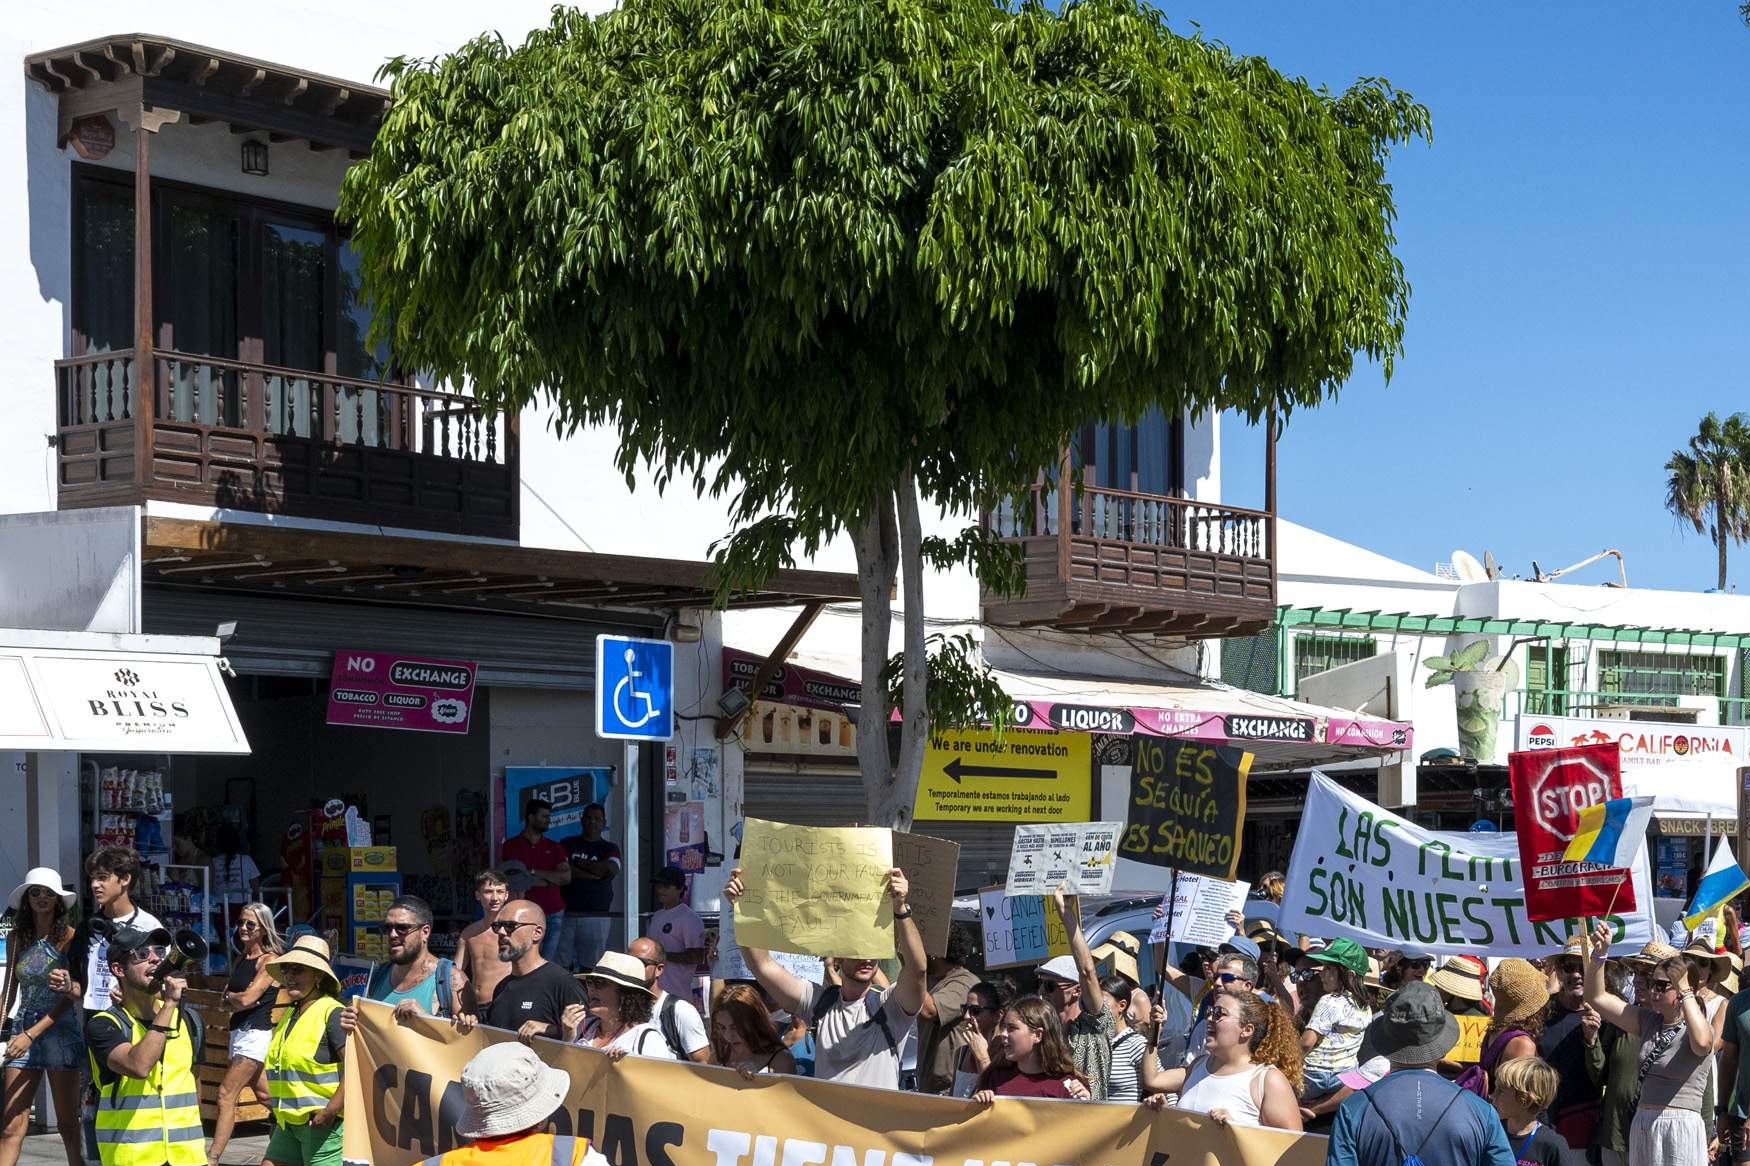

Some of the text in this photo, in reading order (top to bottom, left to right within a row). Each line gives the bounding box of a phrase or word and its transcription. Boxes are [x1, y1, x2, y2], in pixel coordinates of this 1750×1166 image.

[347, 656, 375, 673] NO
[394, 666, 467, 685] EXCHANGE
[336, 691, 376, 702] TOBACCO
[389, 695, 421, 705] LIQUOR
[806, 682, 861, 700] EXCHANGE
[87, 700, 189, 718] BLISS
[1158, 712, 1202, 723] NO EXTRA
[1061, 708, 1123, 730] LIQUOR
[1232, 718, 1306, 739] EXCHANGE
[1162, 724, 1200, 736] CHARGES
[1335, 727, 1346, 736] NO
[931, 738, 950, 751] We
[952, 740, 971, 752] are
[1011, 743, 1069, 757] renovation
[1529, 737, 1555, 746] PEPSI
[1619, 732, 1733, 756] CALIFORNIA
[1136, 739, 1217, 784] NO ES
[928, 788, 1071, 803] Temporalmente estamos trabajando al lado
[1135, 776, 1219, 824] SEQUÍA
[1541, 782, 1603, 818] STOP
[935, 802, 971, 813] Temporary
[984, 806, 995, 814] are
[996, 805, 1023, 815] working
[1032, 806, 1047, 815] next
[1048, 806, 1063, 815] door
[1660, 820, 1701, 833] SNACK
[1083, 838, 1111, 852] AL AÑO
[1121, 820, 1232, 865] ES SAQUEO
[1336, 807, 1400, 867] LAS
[760, 837, 878, 858] TOURISTS IS
[762, 863, 796, 878] NOT
[807, 863, 850, 883] YOUR
[744, 889, 761, 904] IS
[768, 890, 803, 904] THE
[1305, 868, 1367, 930] SON
[778, 915, 848, 937] FAULT
[986, 923, 1067, 953] SE DEFIENDE
